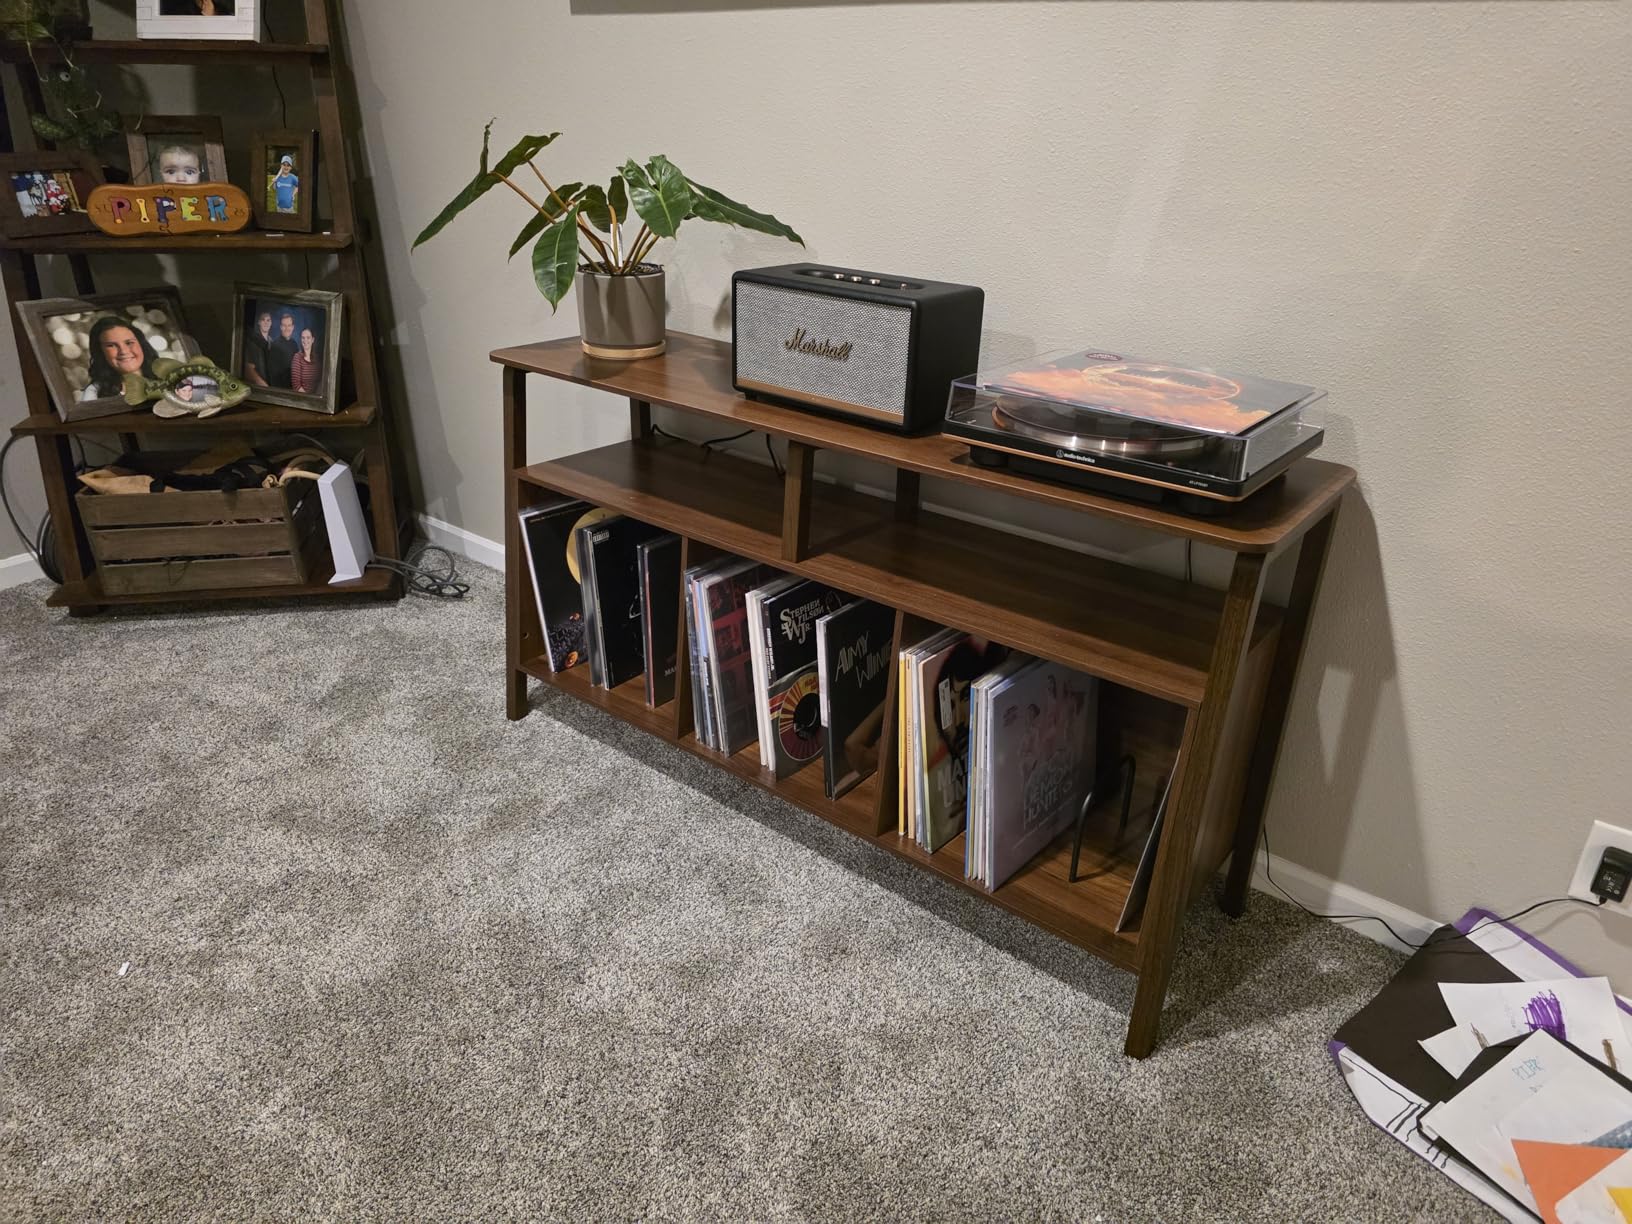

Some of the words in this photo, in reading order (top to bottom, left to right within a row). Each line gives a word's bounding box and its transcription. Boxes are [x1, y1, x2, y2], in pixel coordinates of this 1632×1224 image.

[109, 195, 229, 225] PIPER
[784, 327, 854, 361] Marshall
[779, 599, 821, 626] STEPHEN
[781, 606, 825, 641] WILSON
[834, 631, 869, 682] AMY
